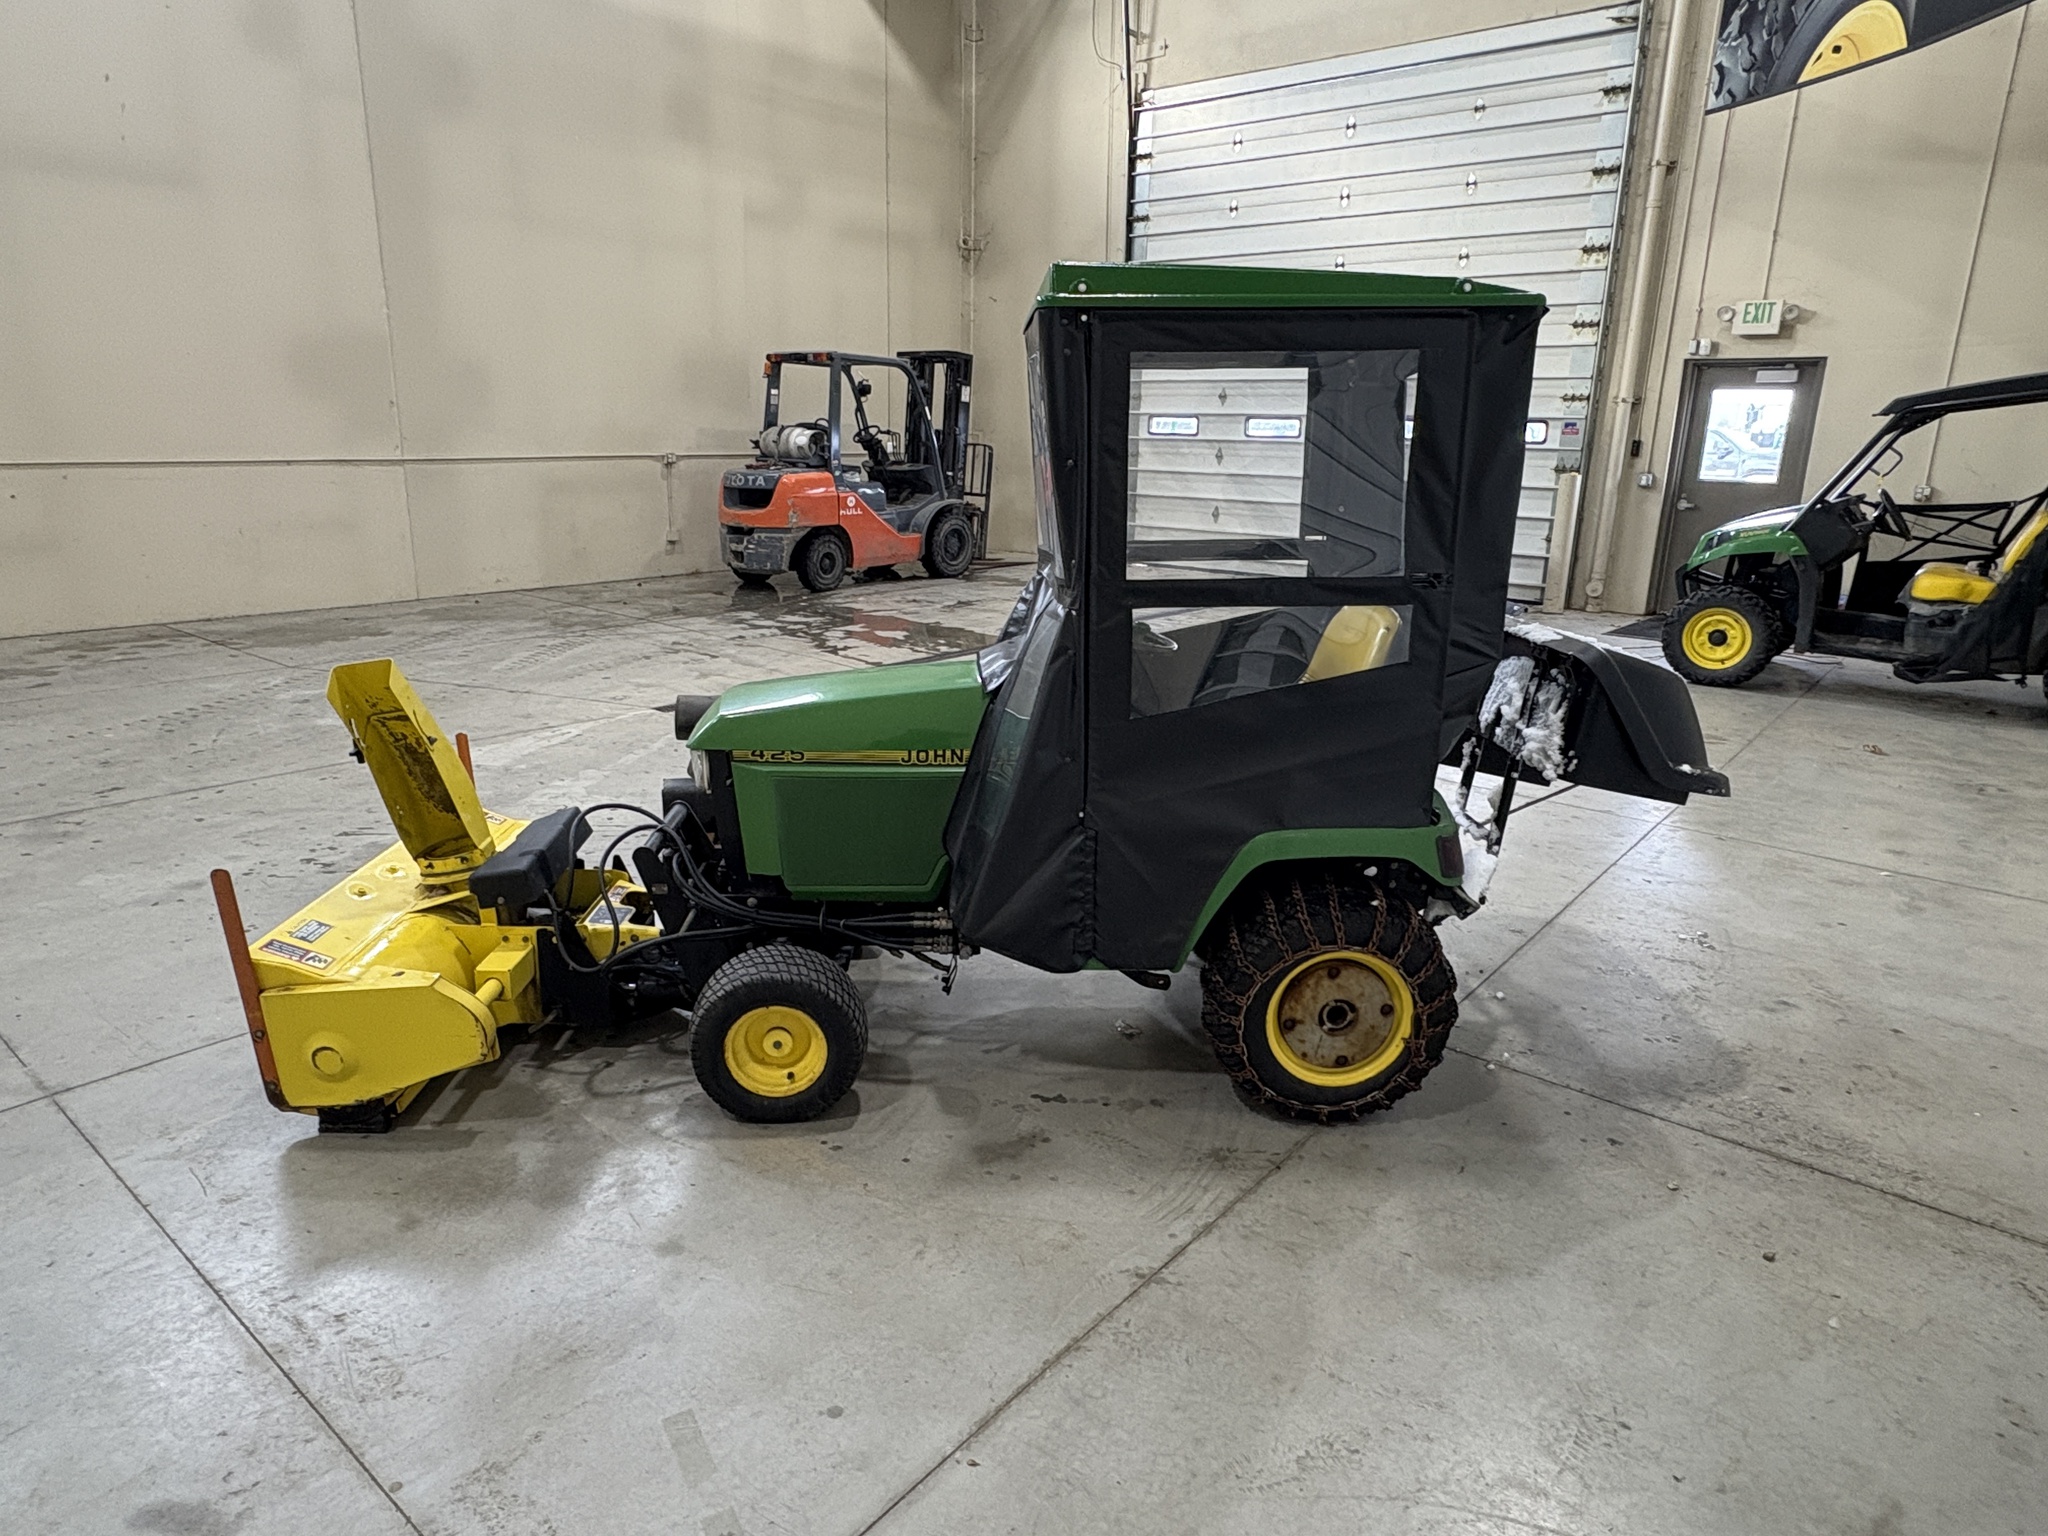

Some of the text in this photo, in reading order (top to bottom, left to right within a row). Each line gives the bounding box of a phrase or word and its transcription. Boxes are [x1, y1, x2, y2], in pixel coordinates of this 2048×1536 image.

[1742, 302, 1777, 324] EXIT
[750, 749, 965, 764] 425 JOHN
